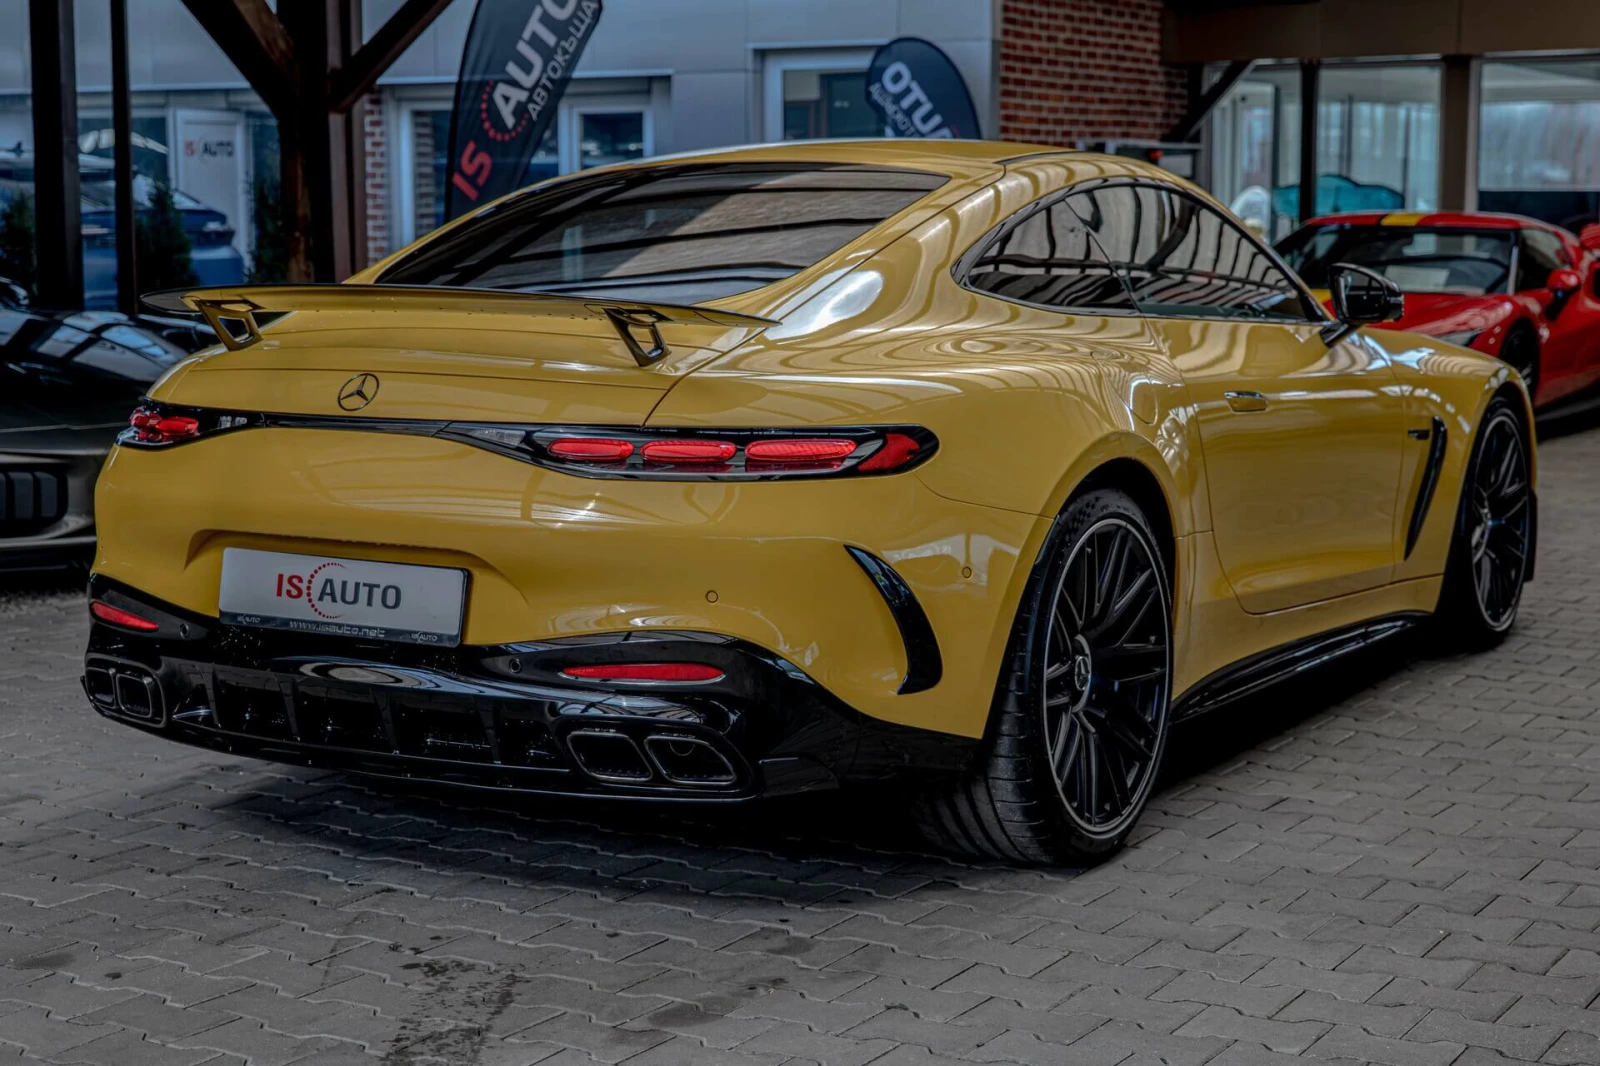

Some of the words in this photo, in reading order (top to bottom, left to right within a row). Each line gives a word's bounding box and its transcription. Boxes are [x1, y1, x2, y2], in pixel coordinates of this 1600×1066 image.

[203, 140, 233, 157] AUTO
[452, 140, 492, 201] IS
[275, 573, 304, 599] IS
[317, 578, 402, 610] AUTO
[289, 620, 386, 638] www.isauto.net
[419, 633, 438, 642] AUTO
